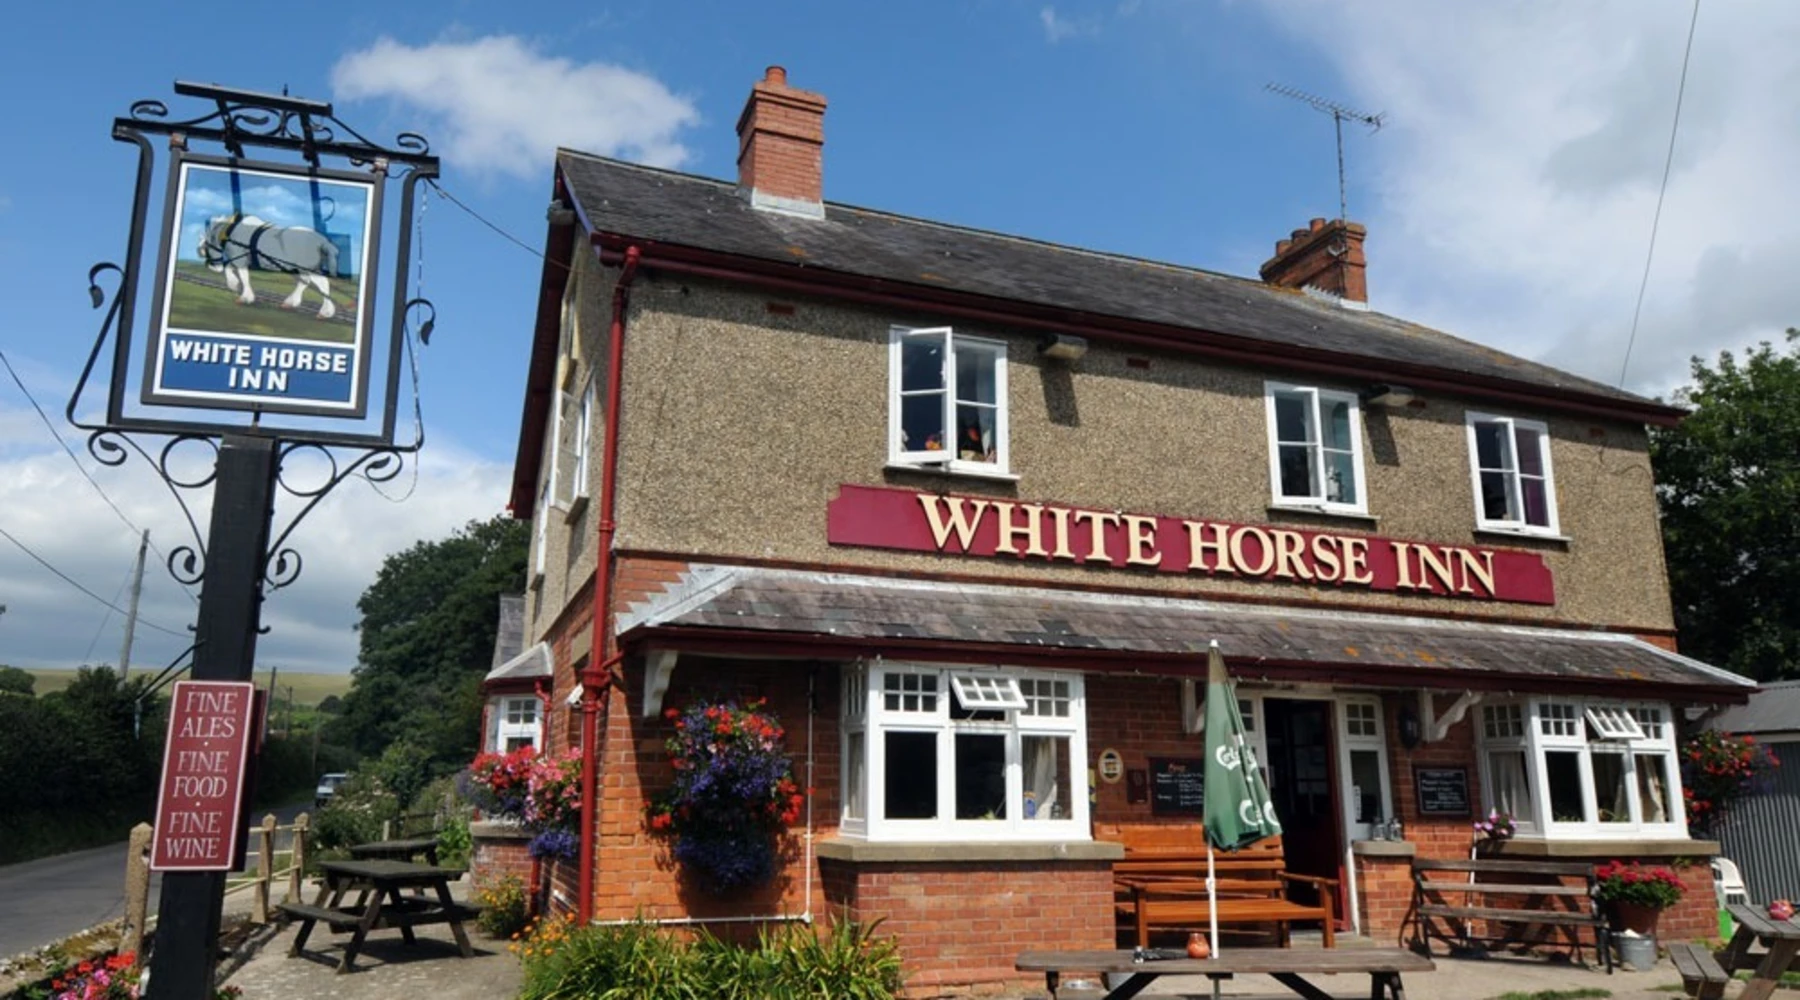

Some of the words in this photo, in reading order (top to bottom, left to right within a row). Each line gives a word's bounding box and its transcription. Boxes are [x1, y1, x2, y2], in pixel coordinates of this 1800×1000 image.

[170, 340, 250, 365] WHITE
[260, 347, 347, 373] HORSE
[229, 368, 288, 391] INN
[917, 494, 1162, 565] WHITE
[1183, 520, 1374, 584] HORSE
[1391, 542, 1495, 596] INN
[185, 692, 238, 713] FINE
[180, 717, 236, 738] ALES
[177, 751, 229, 773] FINE
[173, 776, 228, 798] FOOD
[168, 812, 222, 833] FINE
[165, 838, 220, 859] WINE
